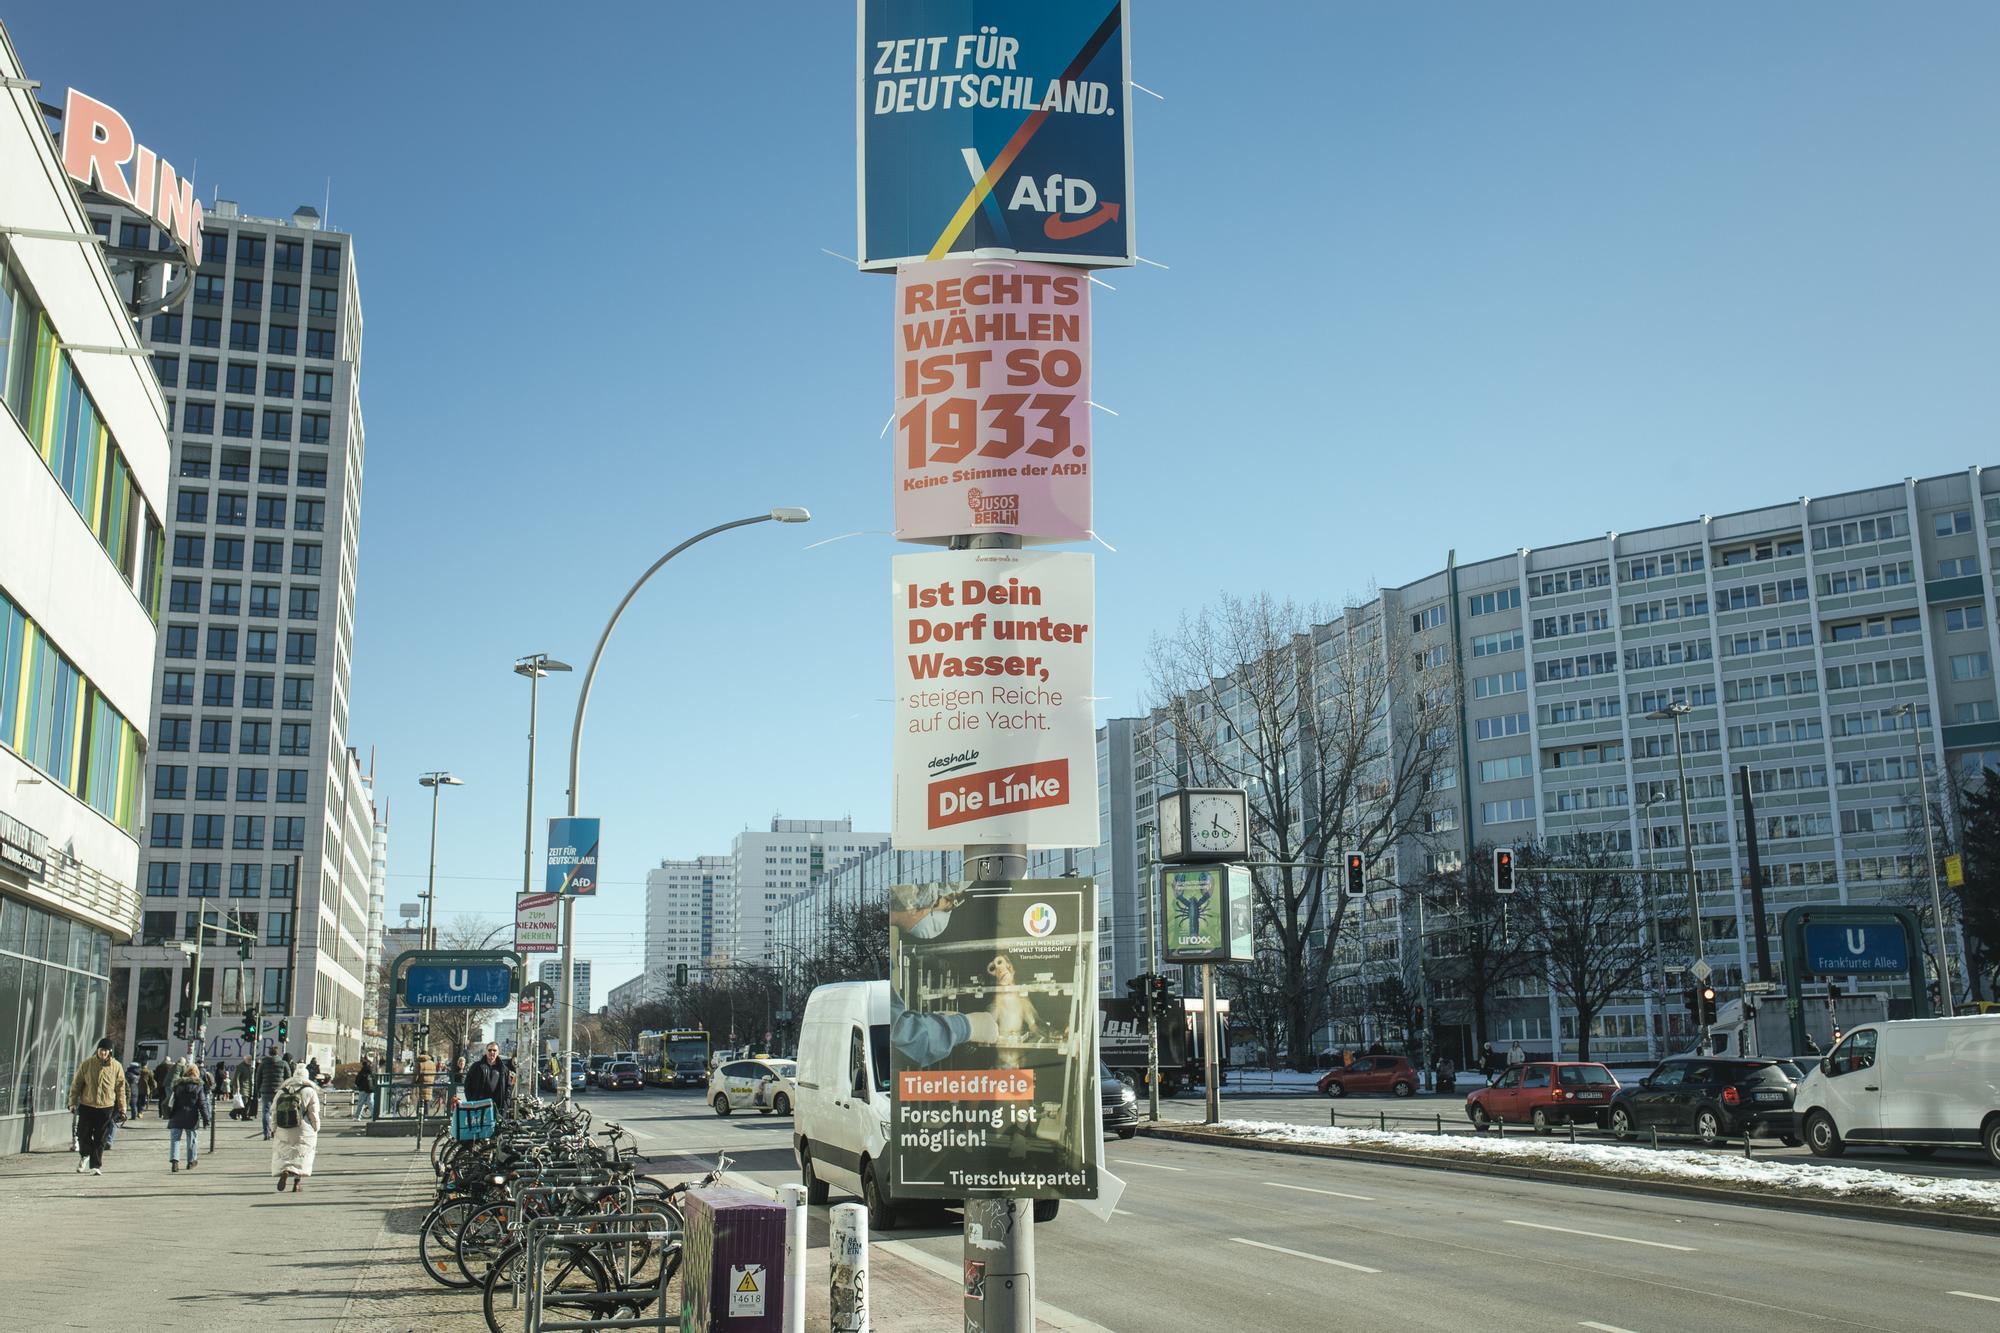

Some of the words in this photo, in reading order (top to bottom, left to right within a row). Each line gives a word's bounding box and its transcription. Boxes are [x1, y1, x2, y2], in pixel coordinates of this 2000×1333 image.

[874, 36, 948, 75] ZEIT
[955, 26, 1020, 70] FÜR
[874, 73, 1115, 116] DEUTSCHLAND.
[63, 87, 204, 267] RING
[1008, 174, 1097, 214] AfD
[904, 274, 1079, 315] RECHTS
[903, 308, 1080, 352] WÄHLEN
[904, 350, 993, 399] IST
[1006, 349, 1082, 388] SO
[899, 393, 1086, 470] 1933.
[904, 475, 948, 491] Keine
[952, 466, 1017, 484] Stimme
[1021, 464, 1048, 477] der
[1052, 463, 1087, 476] AfD!
[979, 496, 1015, 510] JUSOS
[908, 581, 954, 609] Ist
[962, 577, 1041, 607] Dein
[908, 613, 987, 645] Dorf
[993, 616, 1088, 643] unter
[908, 652, 1050, 683] Wasser,
[909, 688, 984, 711] steigen
[992, 686, 1062, 706] Reiche
[909, 713, 942, 733] auf
[948, 711, 980, 730] die
[986, 710, 1051, 731] Yacht.
[928, 750, 979, 769] deshalb
[939, 787, 983, 817] Die
[549, 847, 563, 856] ZEIT
[563, 845, 577, 856] FÜR
[549, 856, 596, 865] DEUTSCHLAND.
[571, 877, 591, 887] AfD
[516, 919, 557, 929] KIEZKÖNIG
[528, 911, 546, 919] ZUM
[1178, 935, 1211, 945] uroxx
[1846, 928, 1866, 955] U
[1818, 957, 1871, 969] Frankfurter
[1874, 957, 1898, 969] Allee
[449, 969, 468, 991] U
[417, 993, 471, 1003] Frankfurter
[474, 993, 498, 1003] Allee
[196, 1035, 275, 1058] MEYER
[904, 1075, 1028, 1095] Tierleidfreie
[901, 1104, 1003, 1128] Forschung
[1010, 1103, 1037, 1123] ist
[900, 1129, 987, 1152] möglich!
[949, 1169, 1086, 1189] Tierschutzpartei
[733, 1294, 761, 1302] 14618
